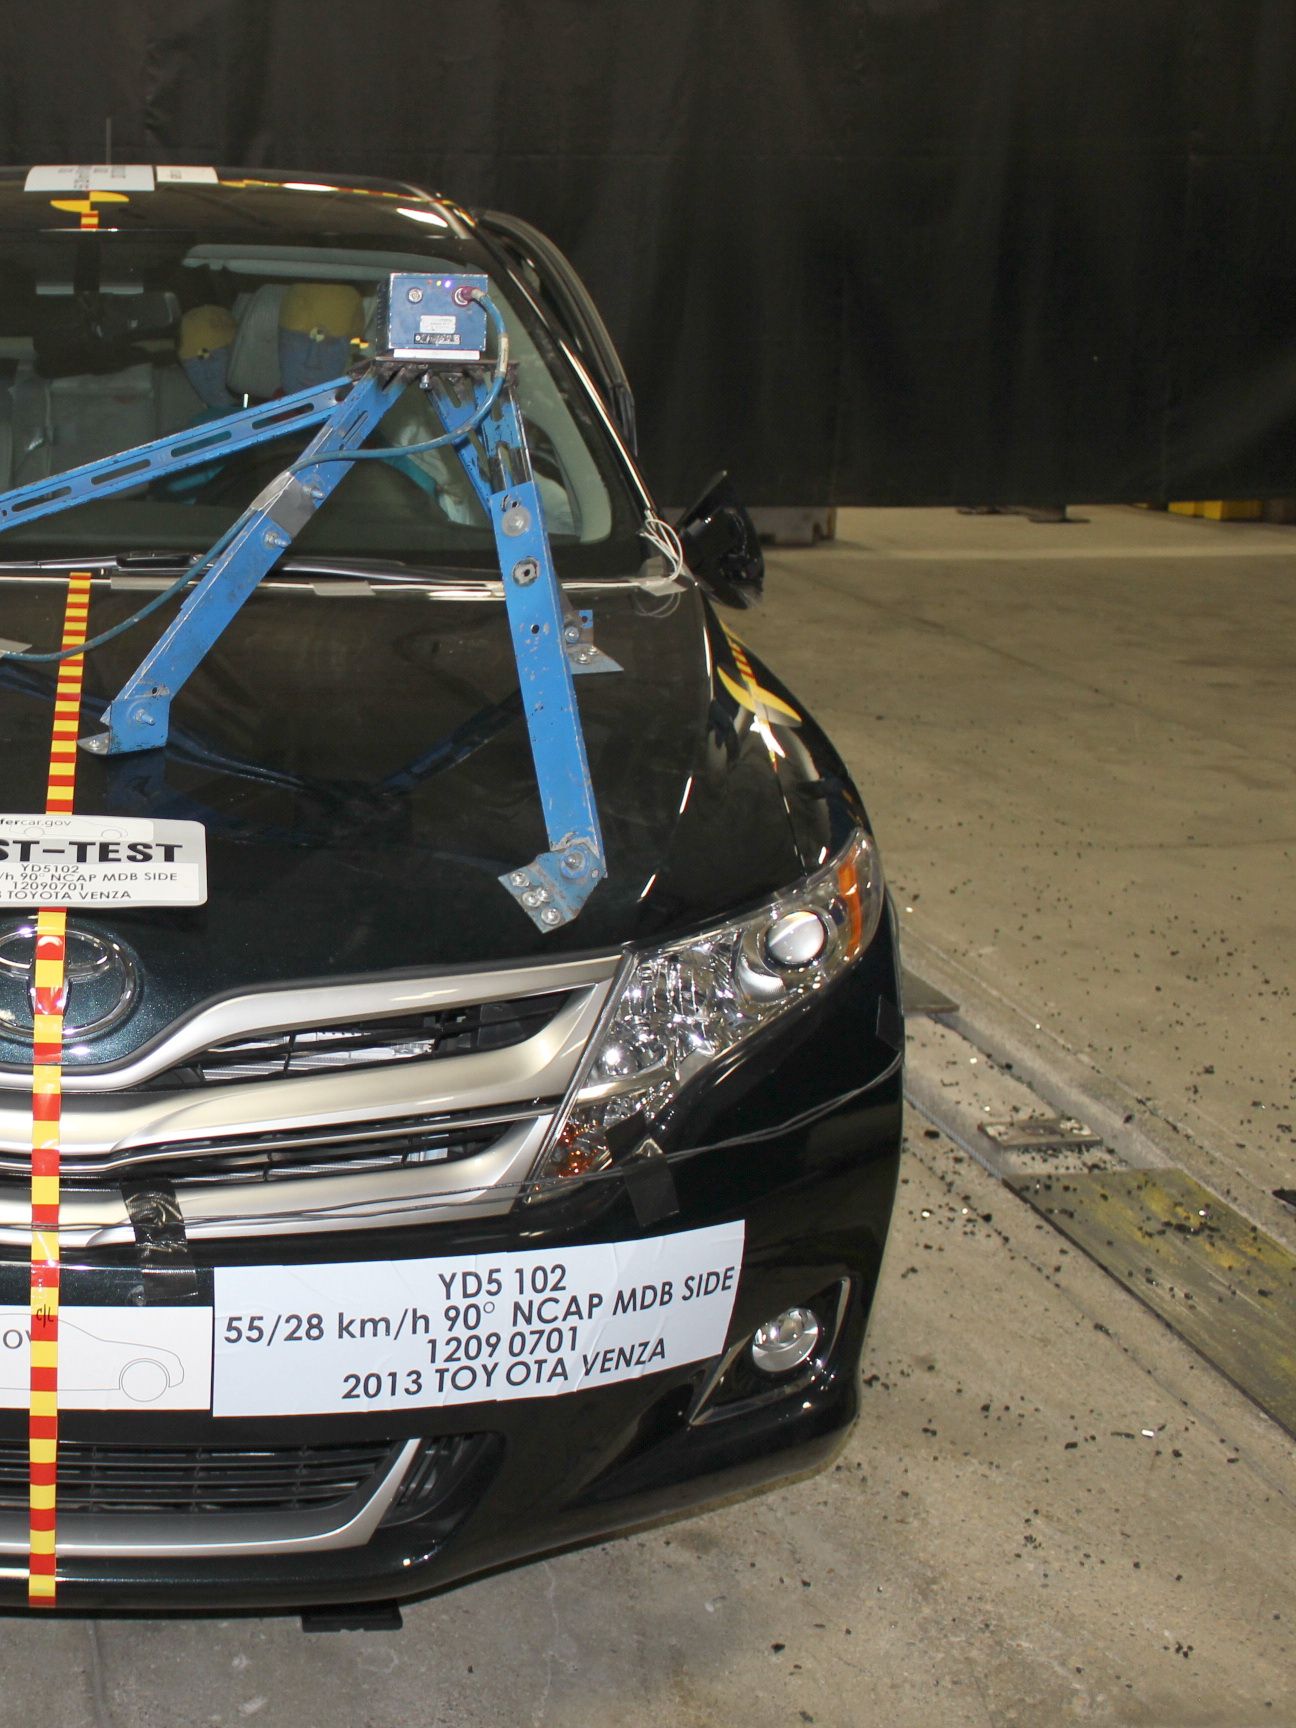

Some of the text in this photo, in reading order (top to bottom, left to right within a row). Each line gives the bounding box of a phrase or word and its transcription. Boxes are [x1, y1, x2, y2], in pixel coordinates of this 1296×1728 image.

[21, 864, 80, 874] YD5102
[50, 873, 97, 883] NCAP
[102, 873, 139, 882] MDB
[143, 872, 178, 881] SIDE
[12, 881, 85, 891] 12090701
[6, 890, 72, 901] TOYOTA
[79, 890, 132, 900] VENZA
[224, 1266, 736, 1347] 55/28 km/h 90° NCAP MDB SIDE
[341, 1337, 667, 1400] 2013 TOYOTA VENZA
